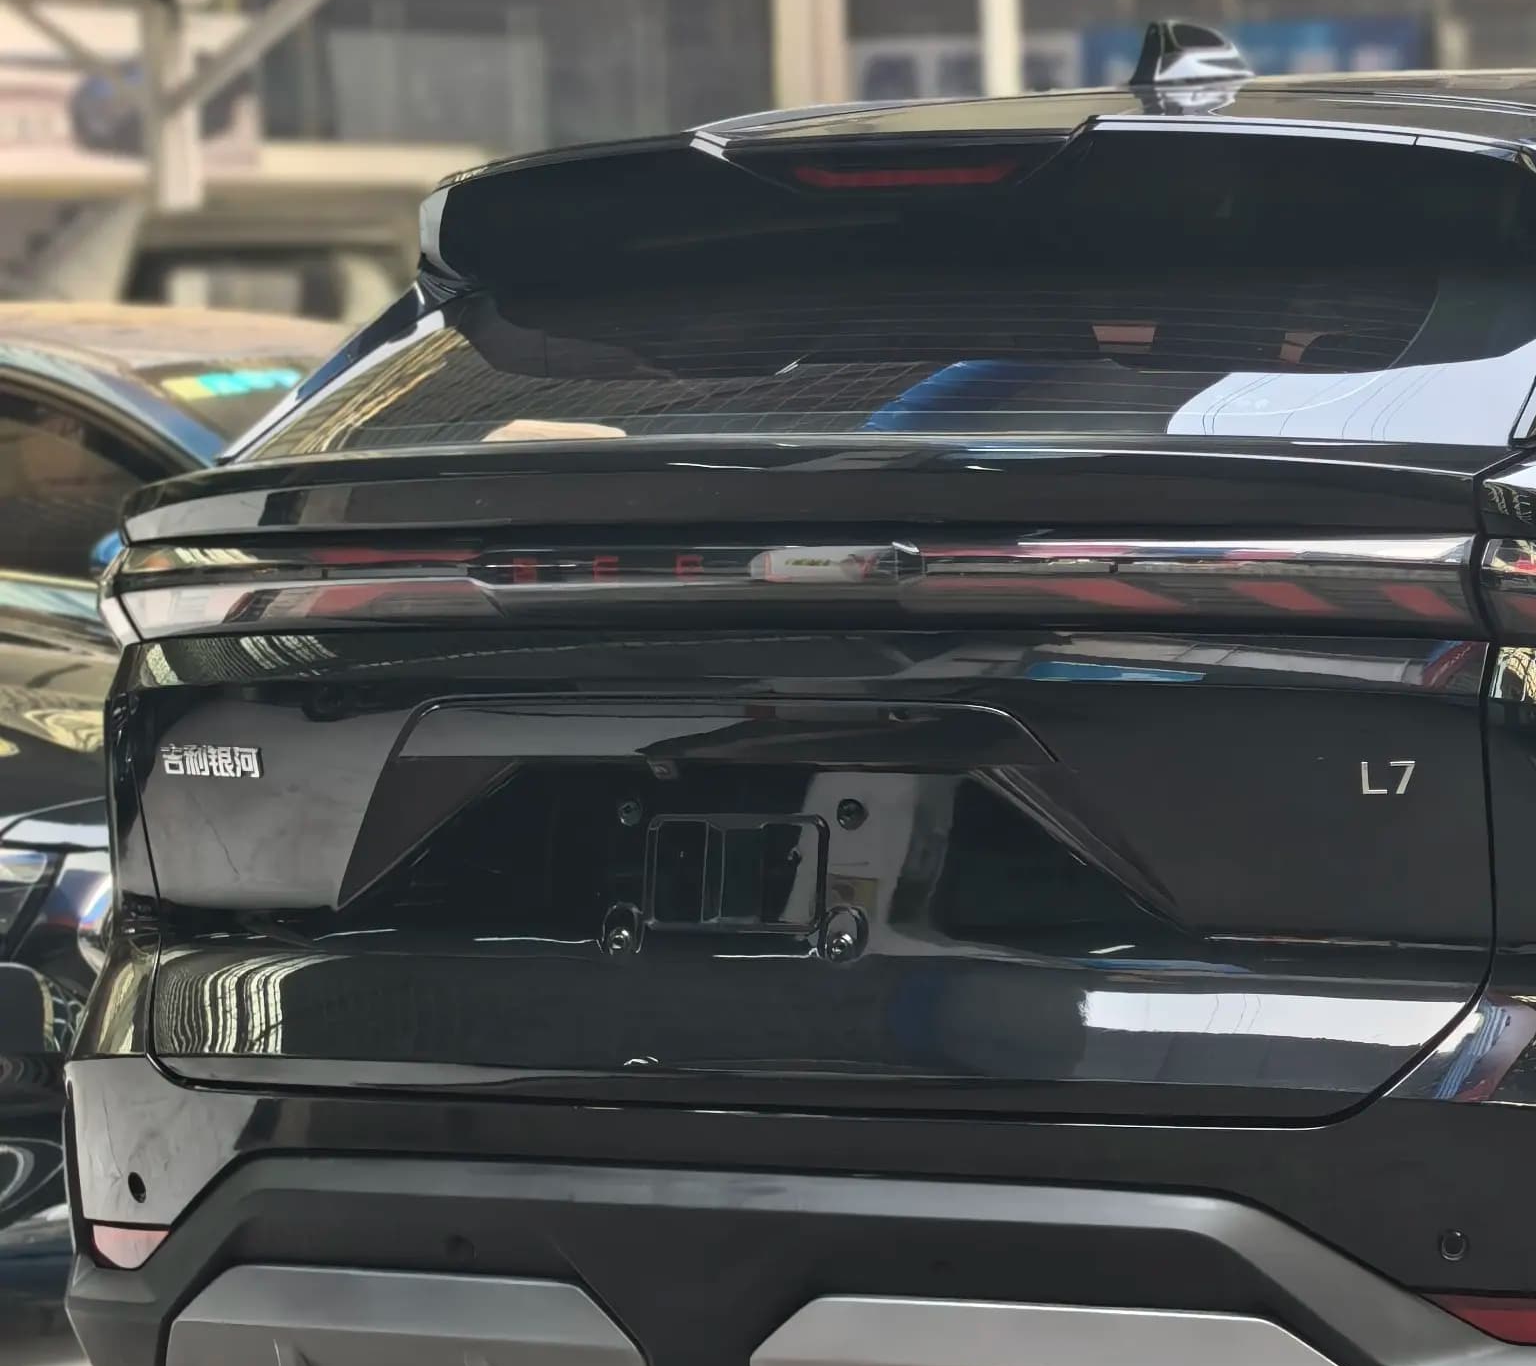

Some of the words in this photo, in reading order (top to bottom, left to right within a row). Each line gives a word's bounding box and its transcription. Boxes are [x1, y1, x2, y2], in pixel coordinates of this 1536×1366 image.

[160, 743, 260, 778] 吉利银河
[1360, 760, 1416, 795] L7
